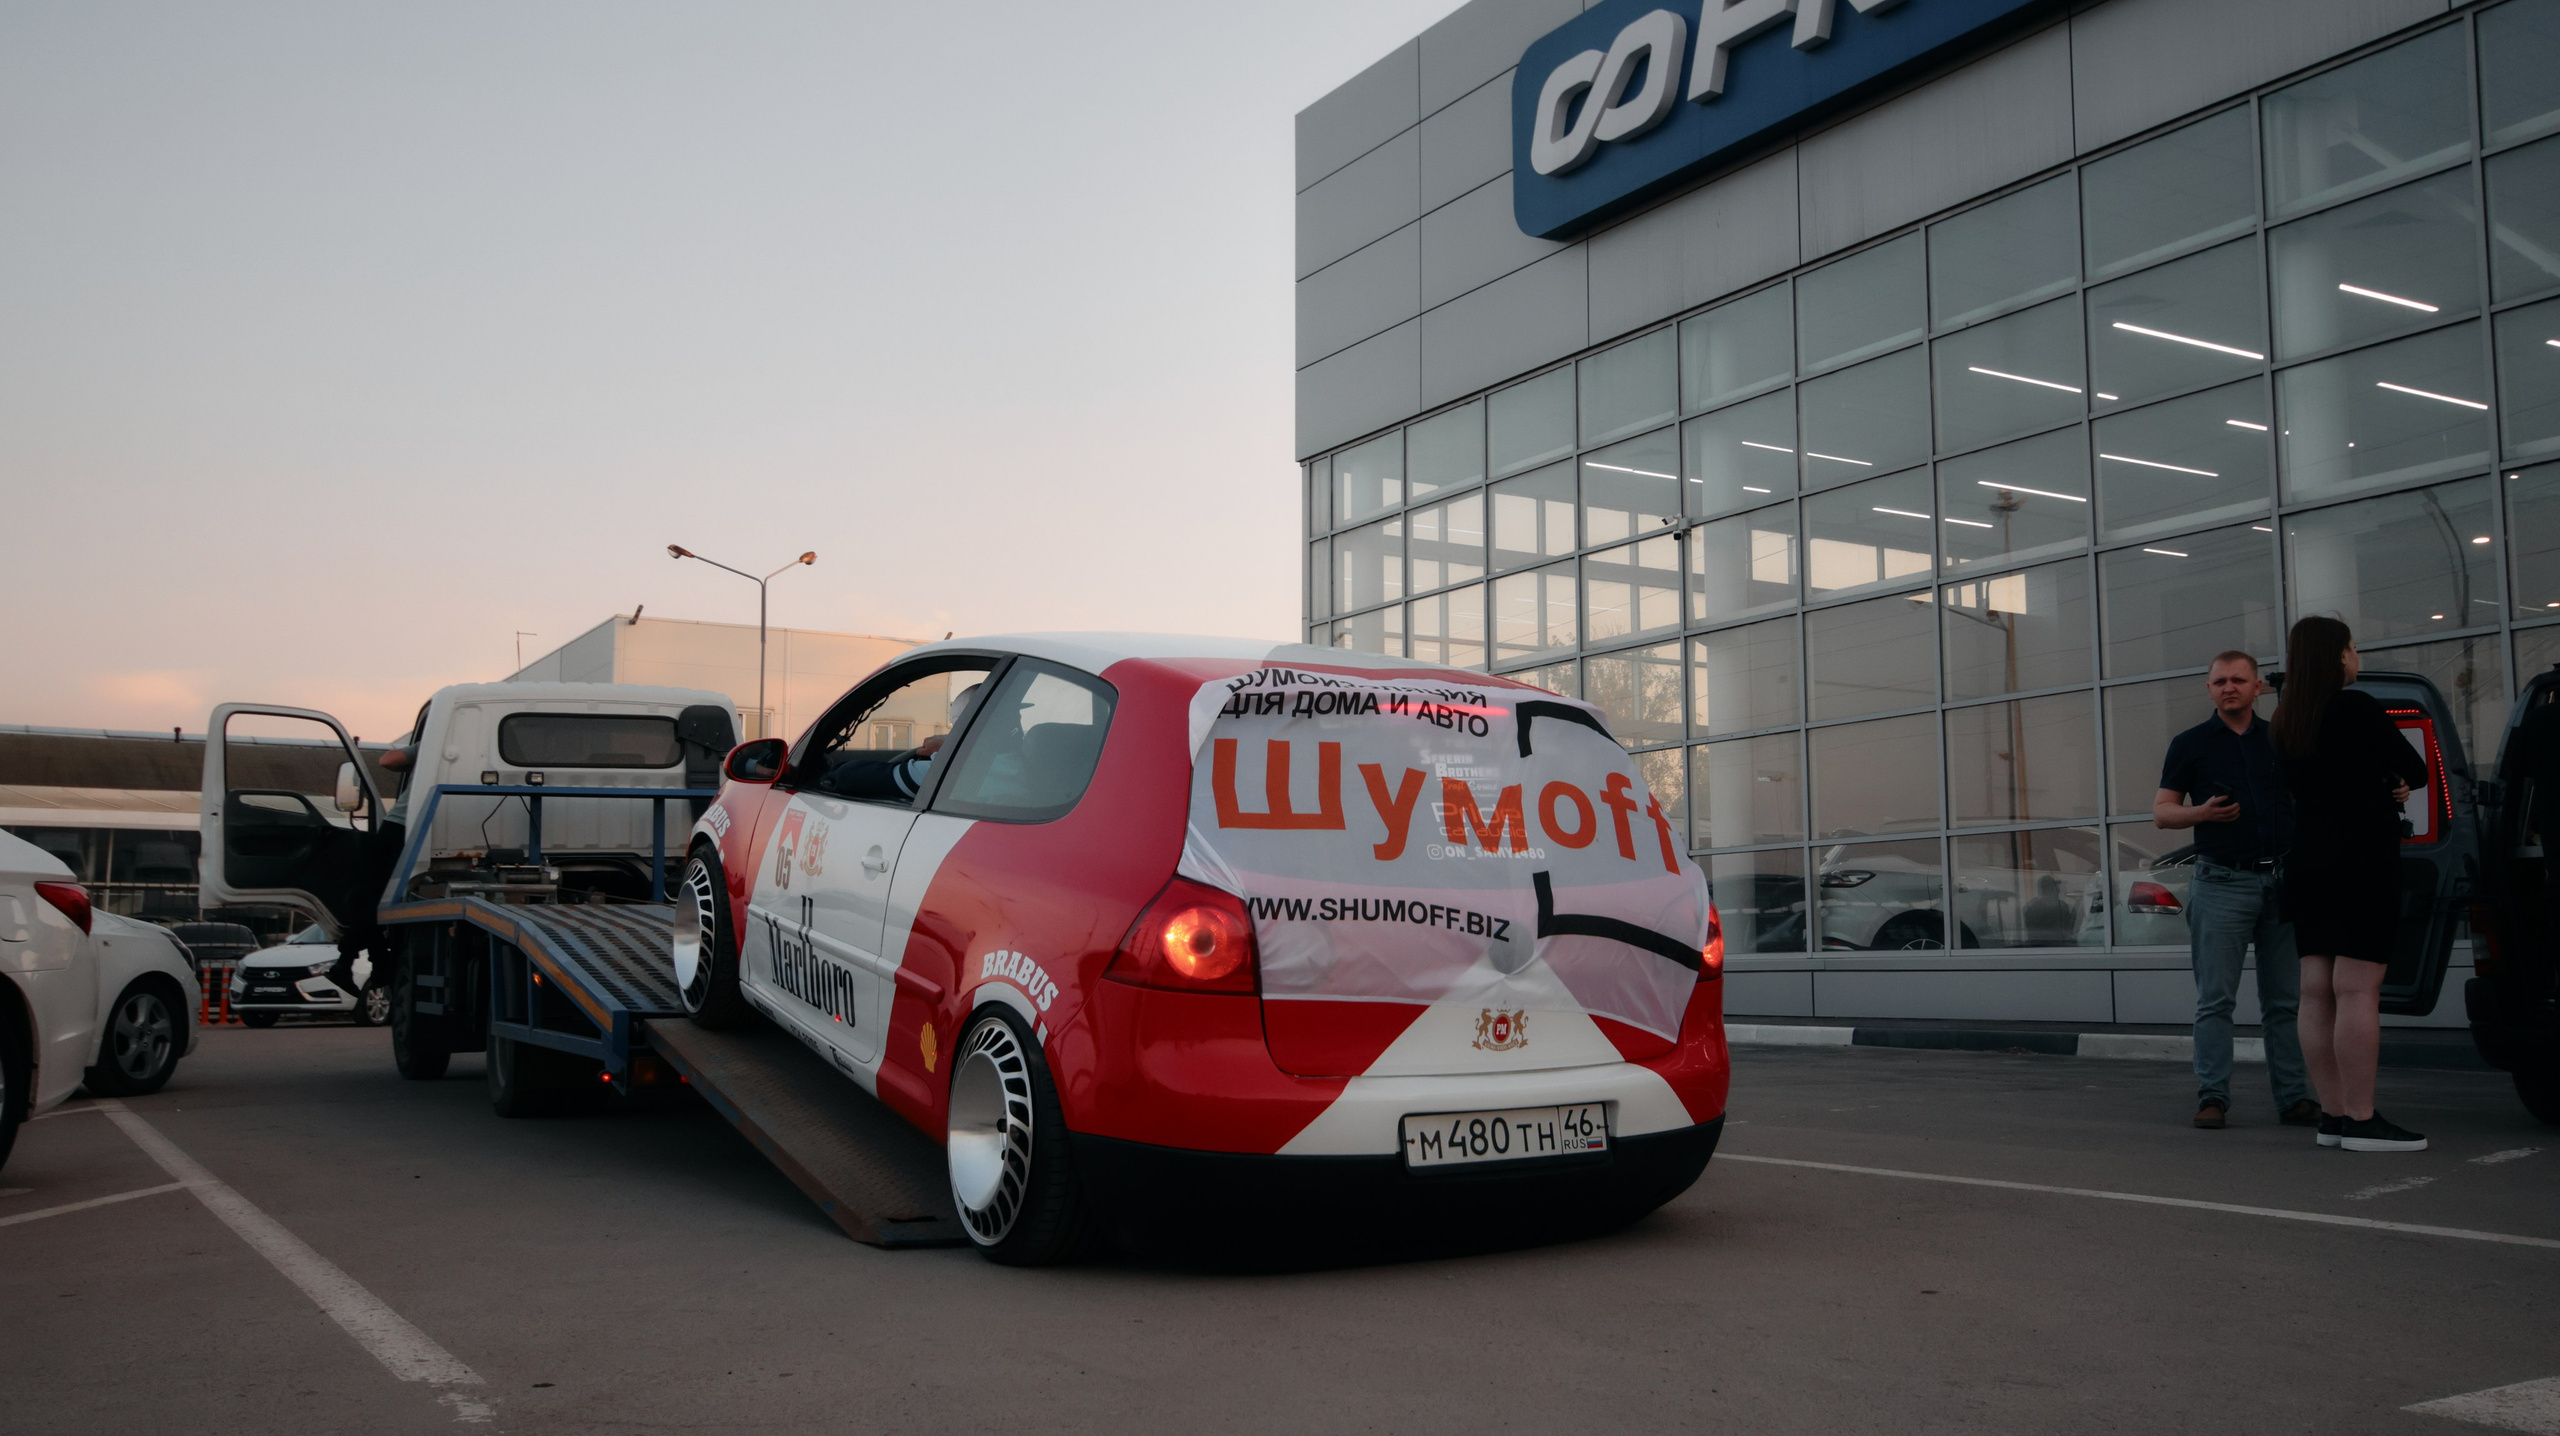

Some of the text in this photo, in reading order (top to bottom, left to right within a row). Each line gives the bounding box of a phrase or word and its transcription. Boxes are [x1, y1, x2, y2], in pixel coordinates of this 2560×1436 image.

[1217, 692, 1284, 719] ДЛЯ
[1291, 691, 1381, 719] ДОМА
[1390, 693, 1408, 716] И
[1416, 700, 1489, 738] АВТО
[1431, 802, 1522, 824] Pride
[1439, 827, 1528, 838] car audio
[775, 846, 793, 890] 05
[764, 894, 856, 1028] Marlboro
[981, 950, 1059, 1012] BRABUS
[1564, 1108, 1594, 1137] 46
[1563, 1138, 1587, 1150] RUS
